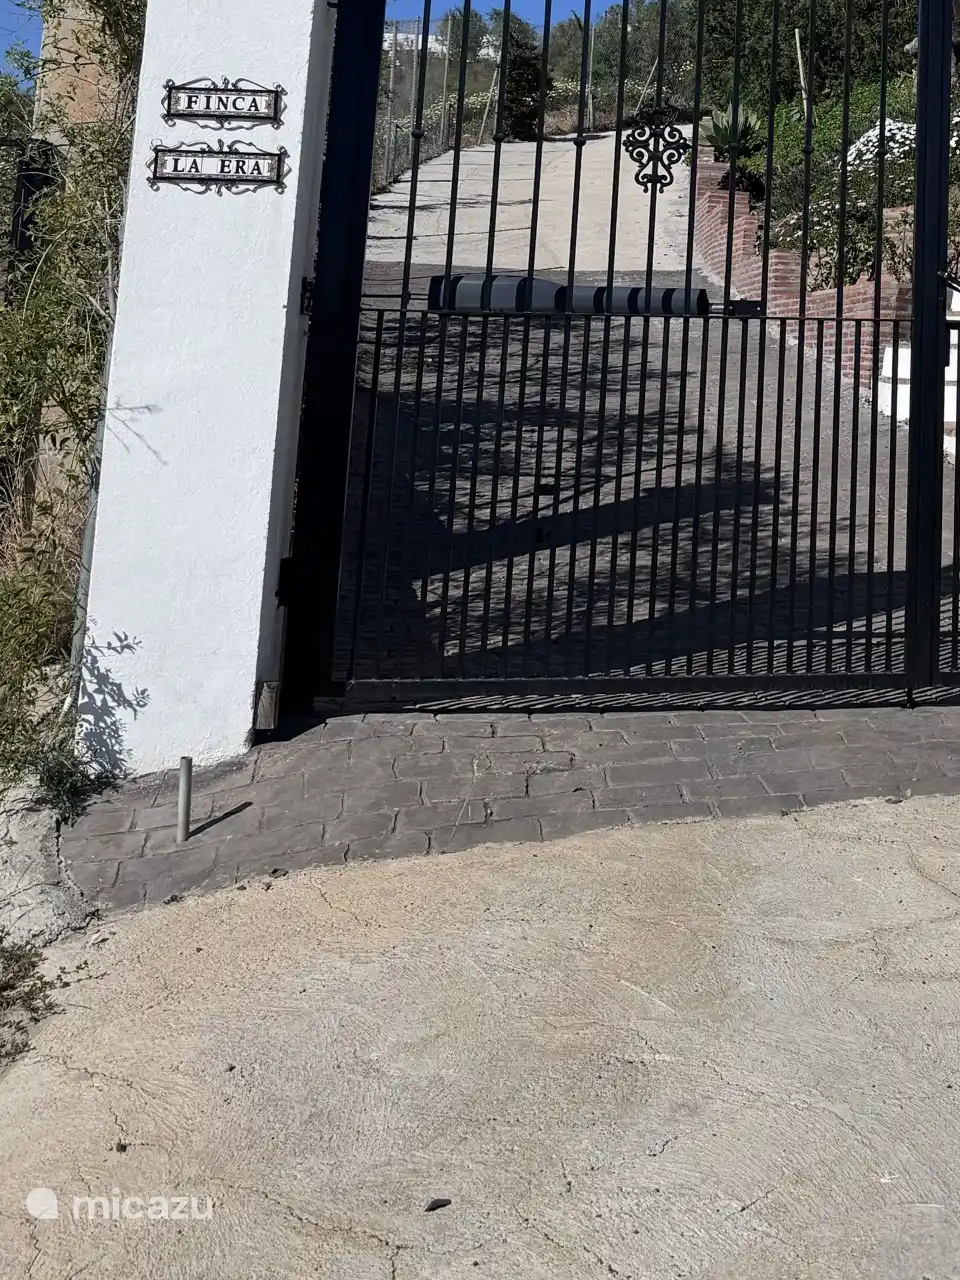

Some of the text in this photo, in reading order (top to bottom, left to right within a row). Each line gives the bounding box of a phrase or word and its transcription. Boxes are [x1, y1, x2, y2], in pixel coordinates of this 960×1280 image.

[185, 95, 261, 112] FINCA
[171, 158, 263, 176] LA ERA
